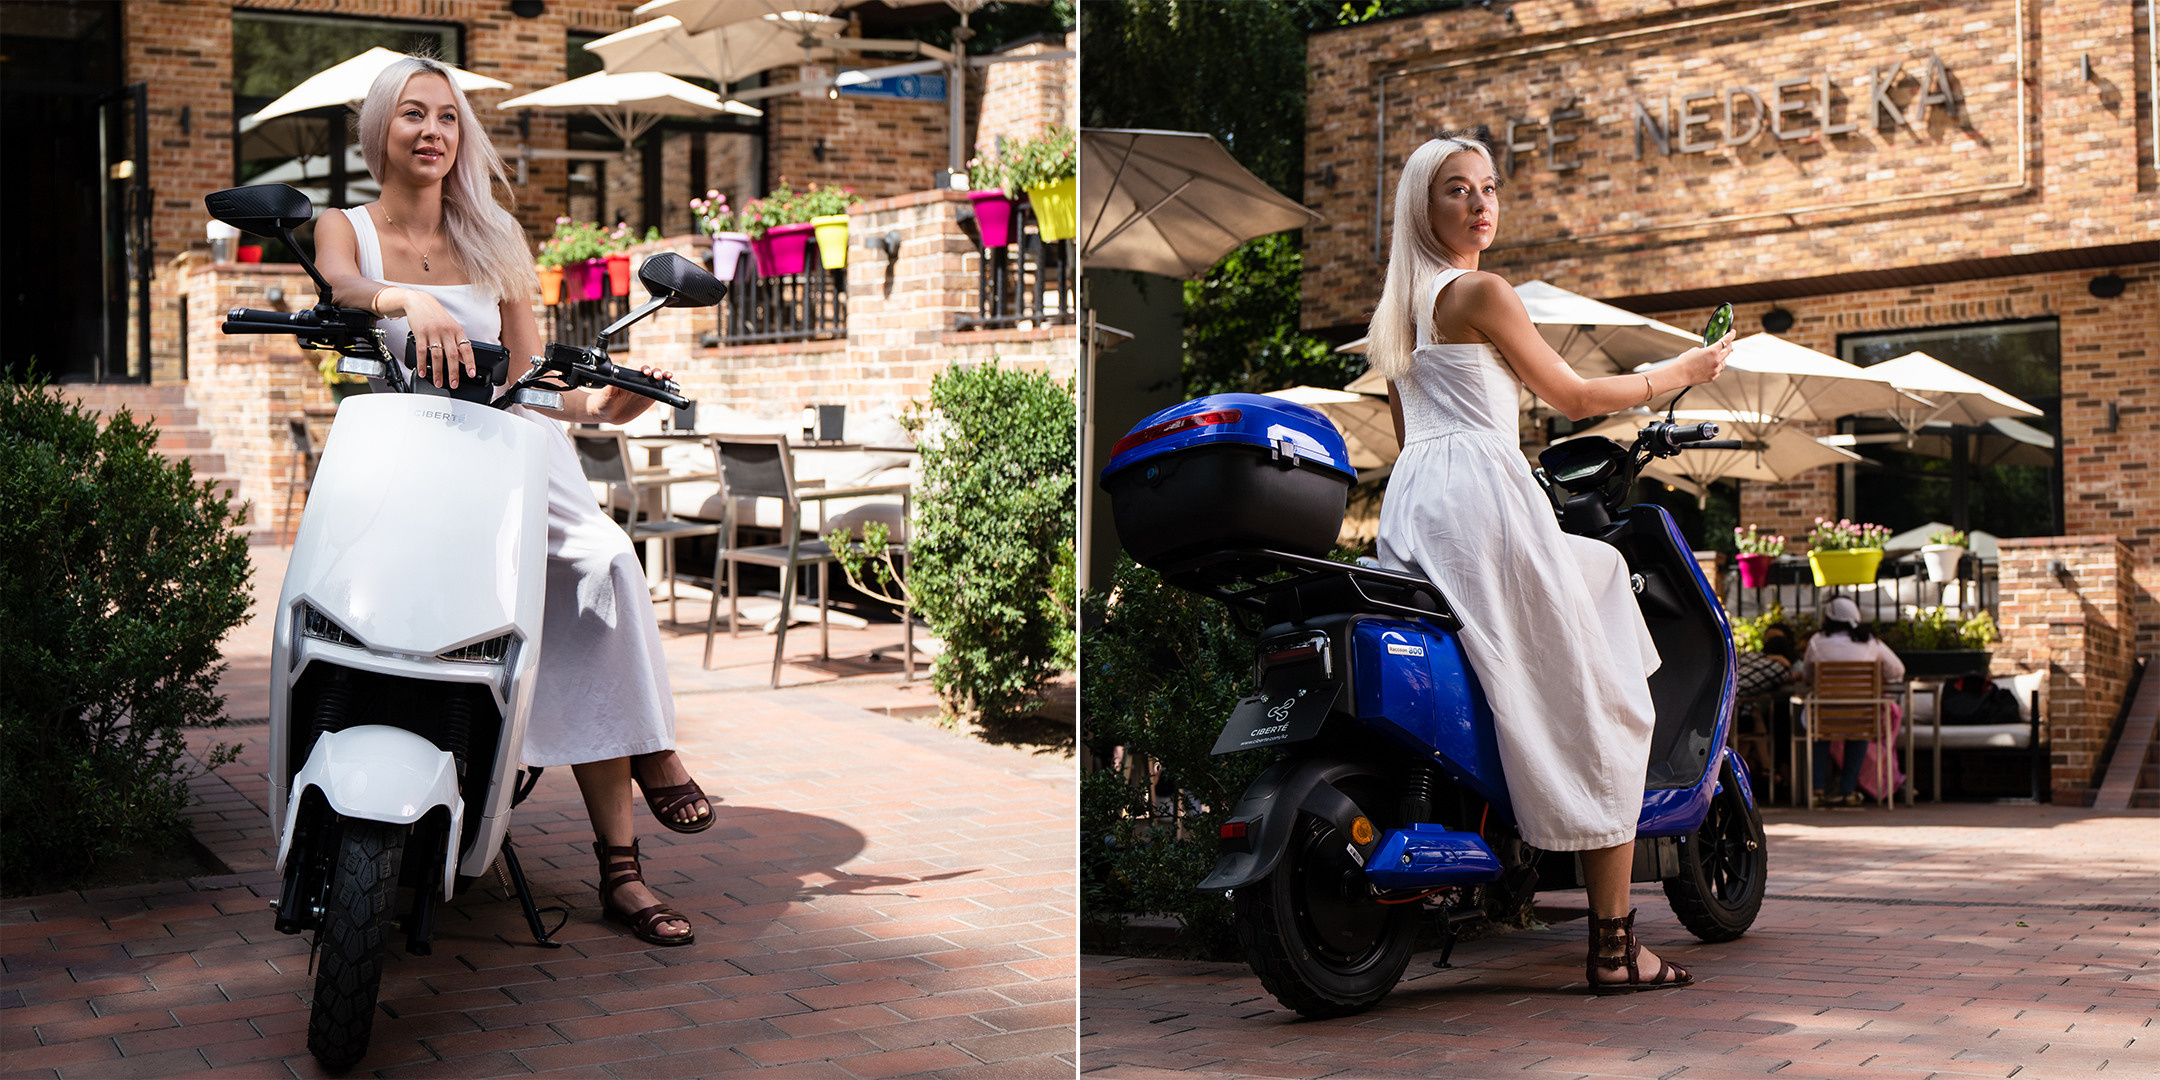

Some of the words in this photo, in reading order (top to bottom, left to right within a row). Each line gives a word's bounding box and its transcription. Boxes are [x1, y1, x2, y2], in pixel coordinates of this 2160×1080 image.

[1478, 97, 1583, 178] FÉ
[1634, 54, 1956, 160] NEDELKA
[1250, 721, 1290, 737] CIBERTÉ
